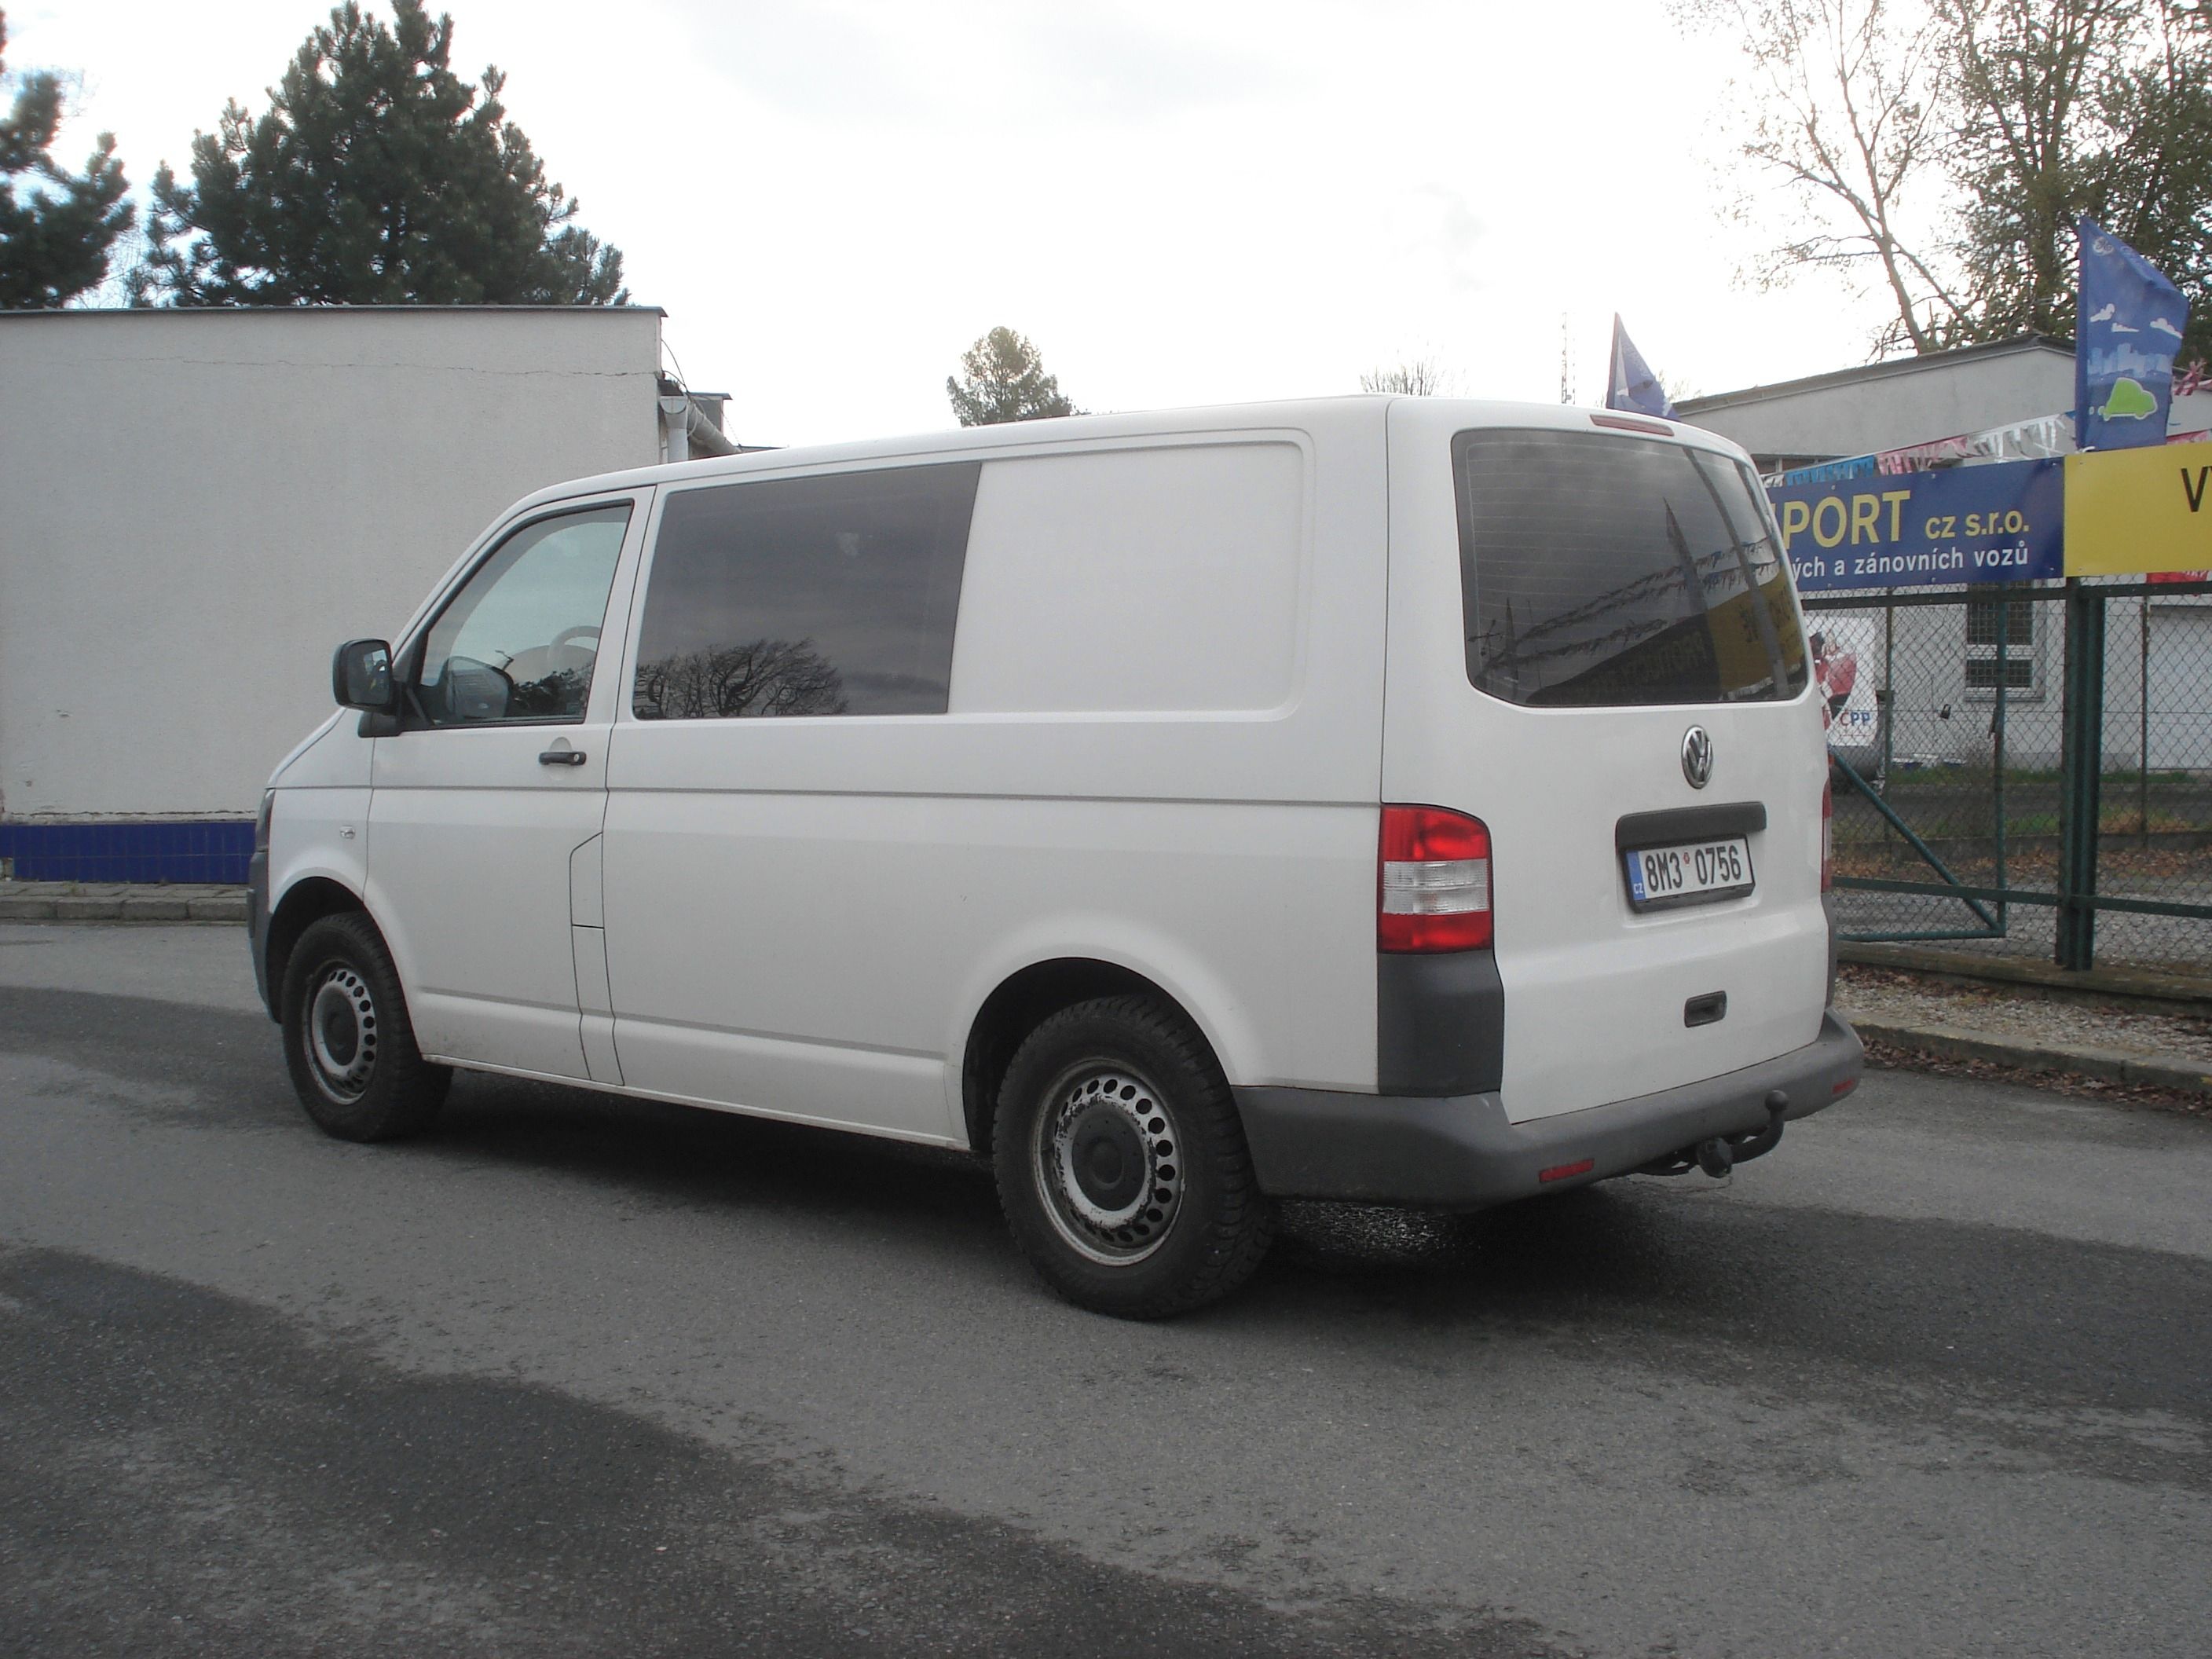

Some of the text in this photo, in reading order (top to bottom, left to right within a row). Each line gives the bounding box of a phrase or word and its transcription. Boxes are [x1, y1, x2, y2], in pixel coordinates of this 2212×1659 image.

[2181, 466, 2212, 513] V
[1771, 489, 1911, 549] PORT
[1965, 510, 2030, 537] s.r.o.
[1834, 559, 1844, 575] a
[1855, 546, 1963, 574] zánovních
[1974, 540, 2028, 567] vozů
[1633, 844, 1741, 895] CZ 8M3 0756
